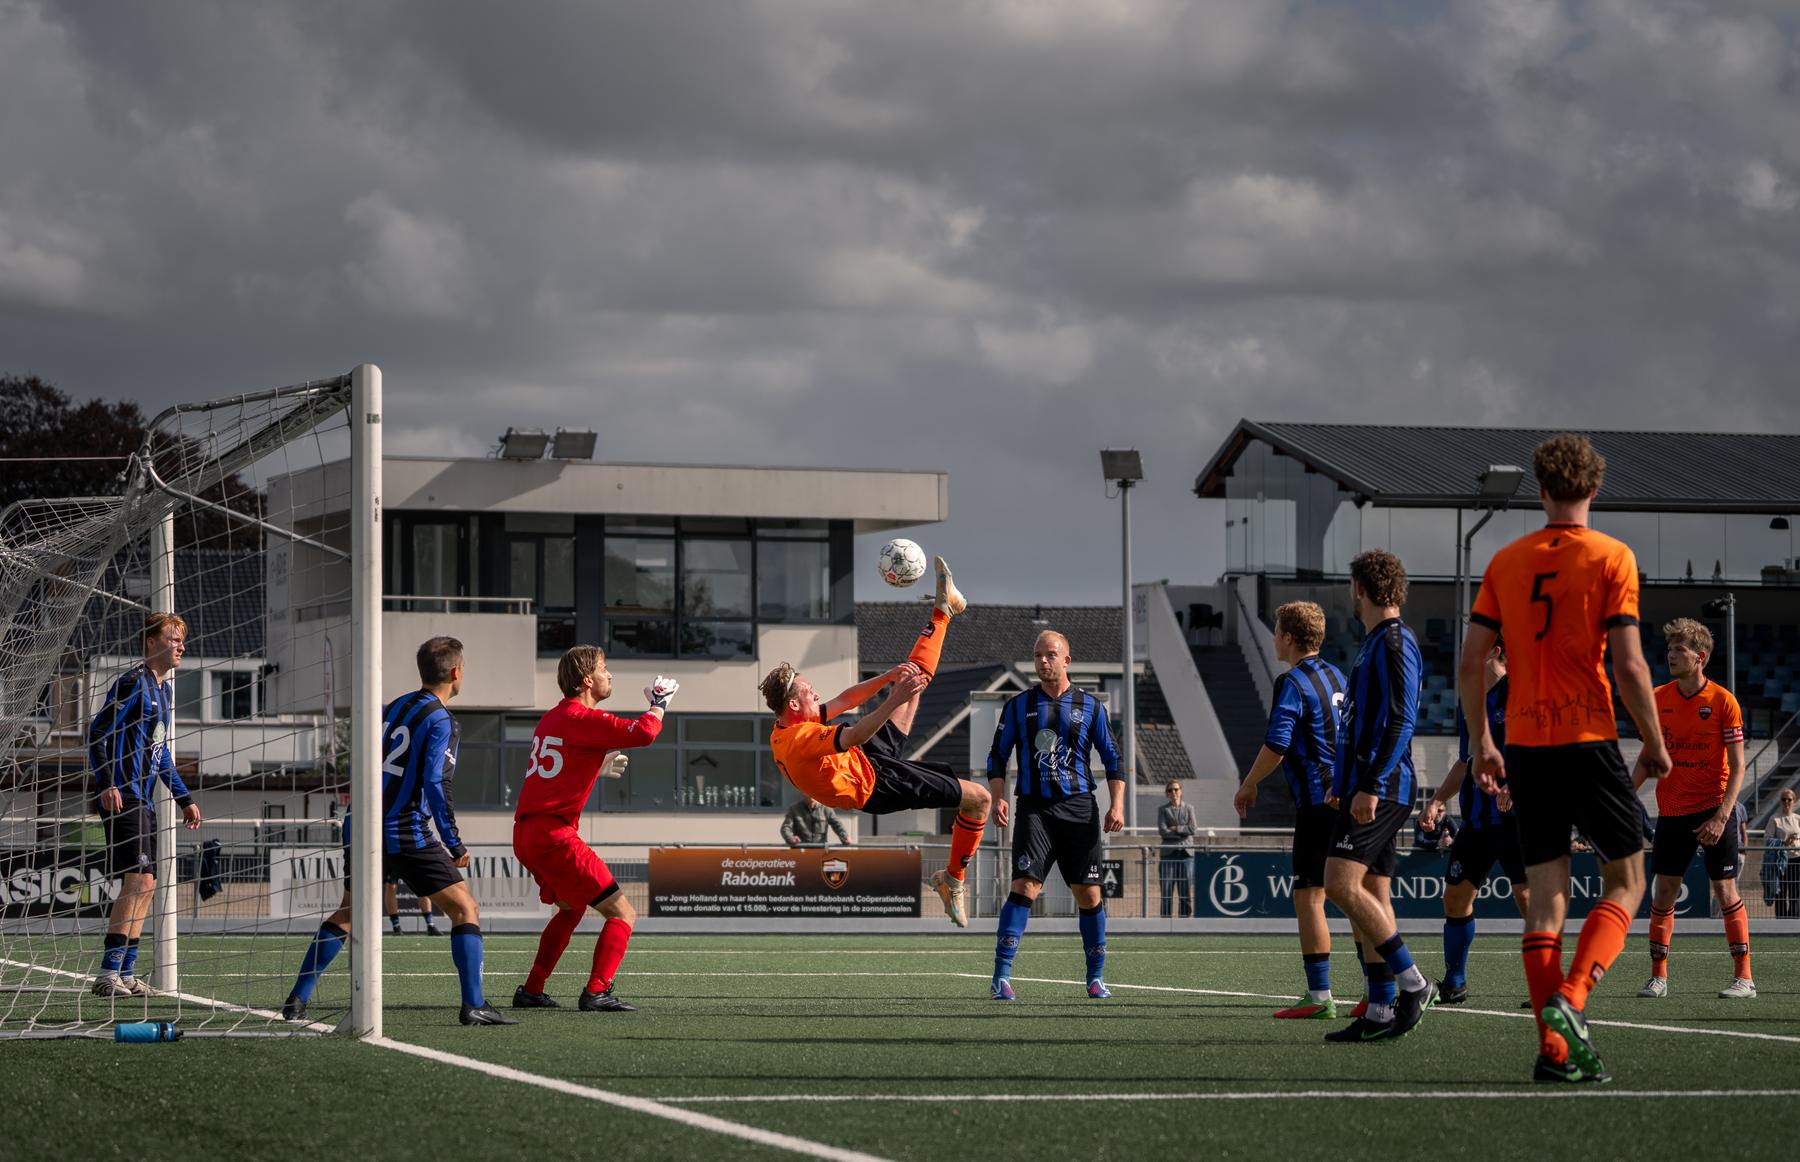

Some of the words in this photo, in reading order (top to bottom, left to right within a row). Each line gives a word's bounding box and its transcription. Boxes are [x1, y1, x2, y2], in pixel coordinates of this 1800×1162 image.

[1530, 571, 1559, 641] 5
[721, 858, 733, 869] de
[734, 858, 796, 870] coöperatieve
[721, 871, 796, 887] Rabobank
[1103, 869, 1118, 884] A
[669, 895, 688, 904] Jong
[855, 894, 915, 904] Coöperatiefonds
[693, 904, 721, 912] donatie
[737, 904, 743, 912] €
[790, 904, 801, 912] de
[801, 904, 842, 914] investering
[842, 904, 850, 912] in
[851, 904, 861, 912] de
[862, 904, 912, 914] zonnepanelen
